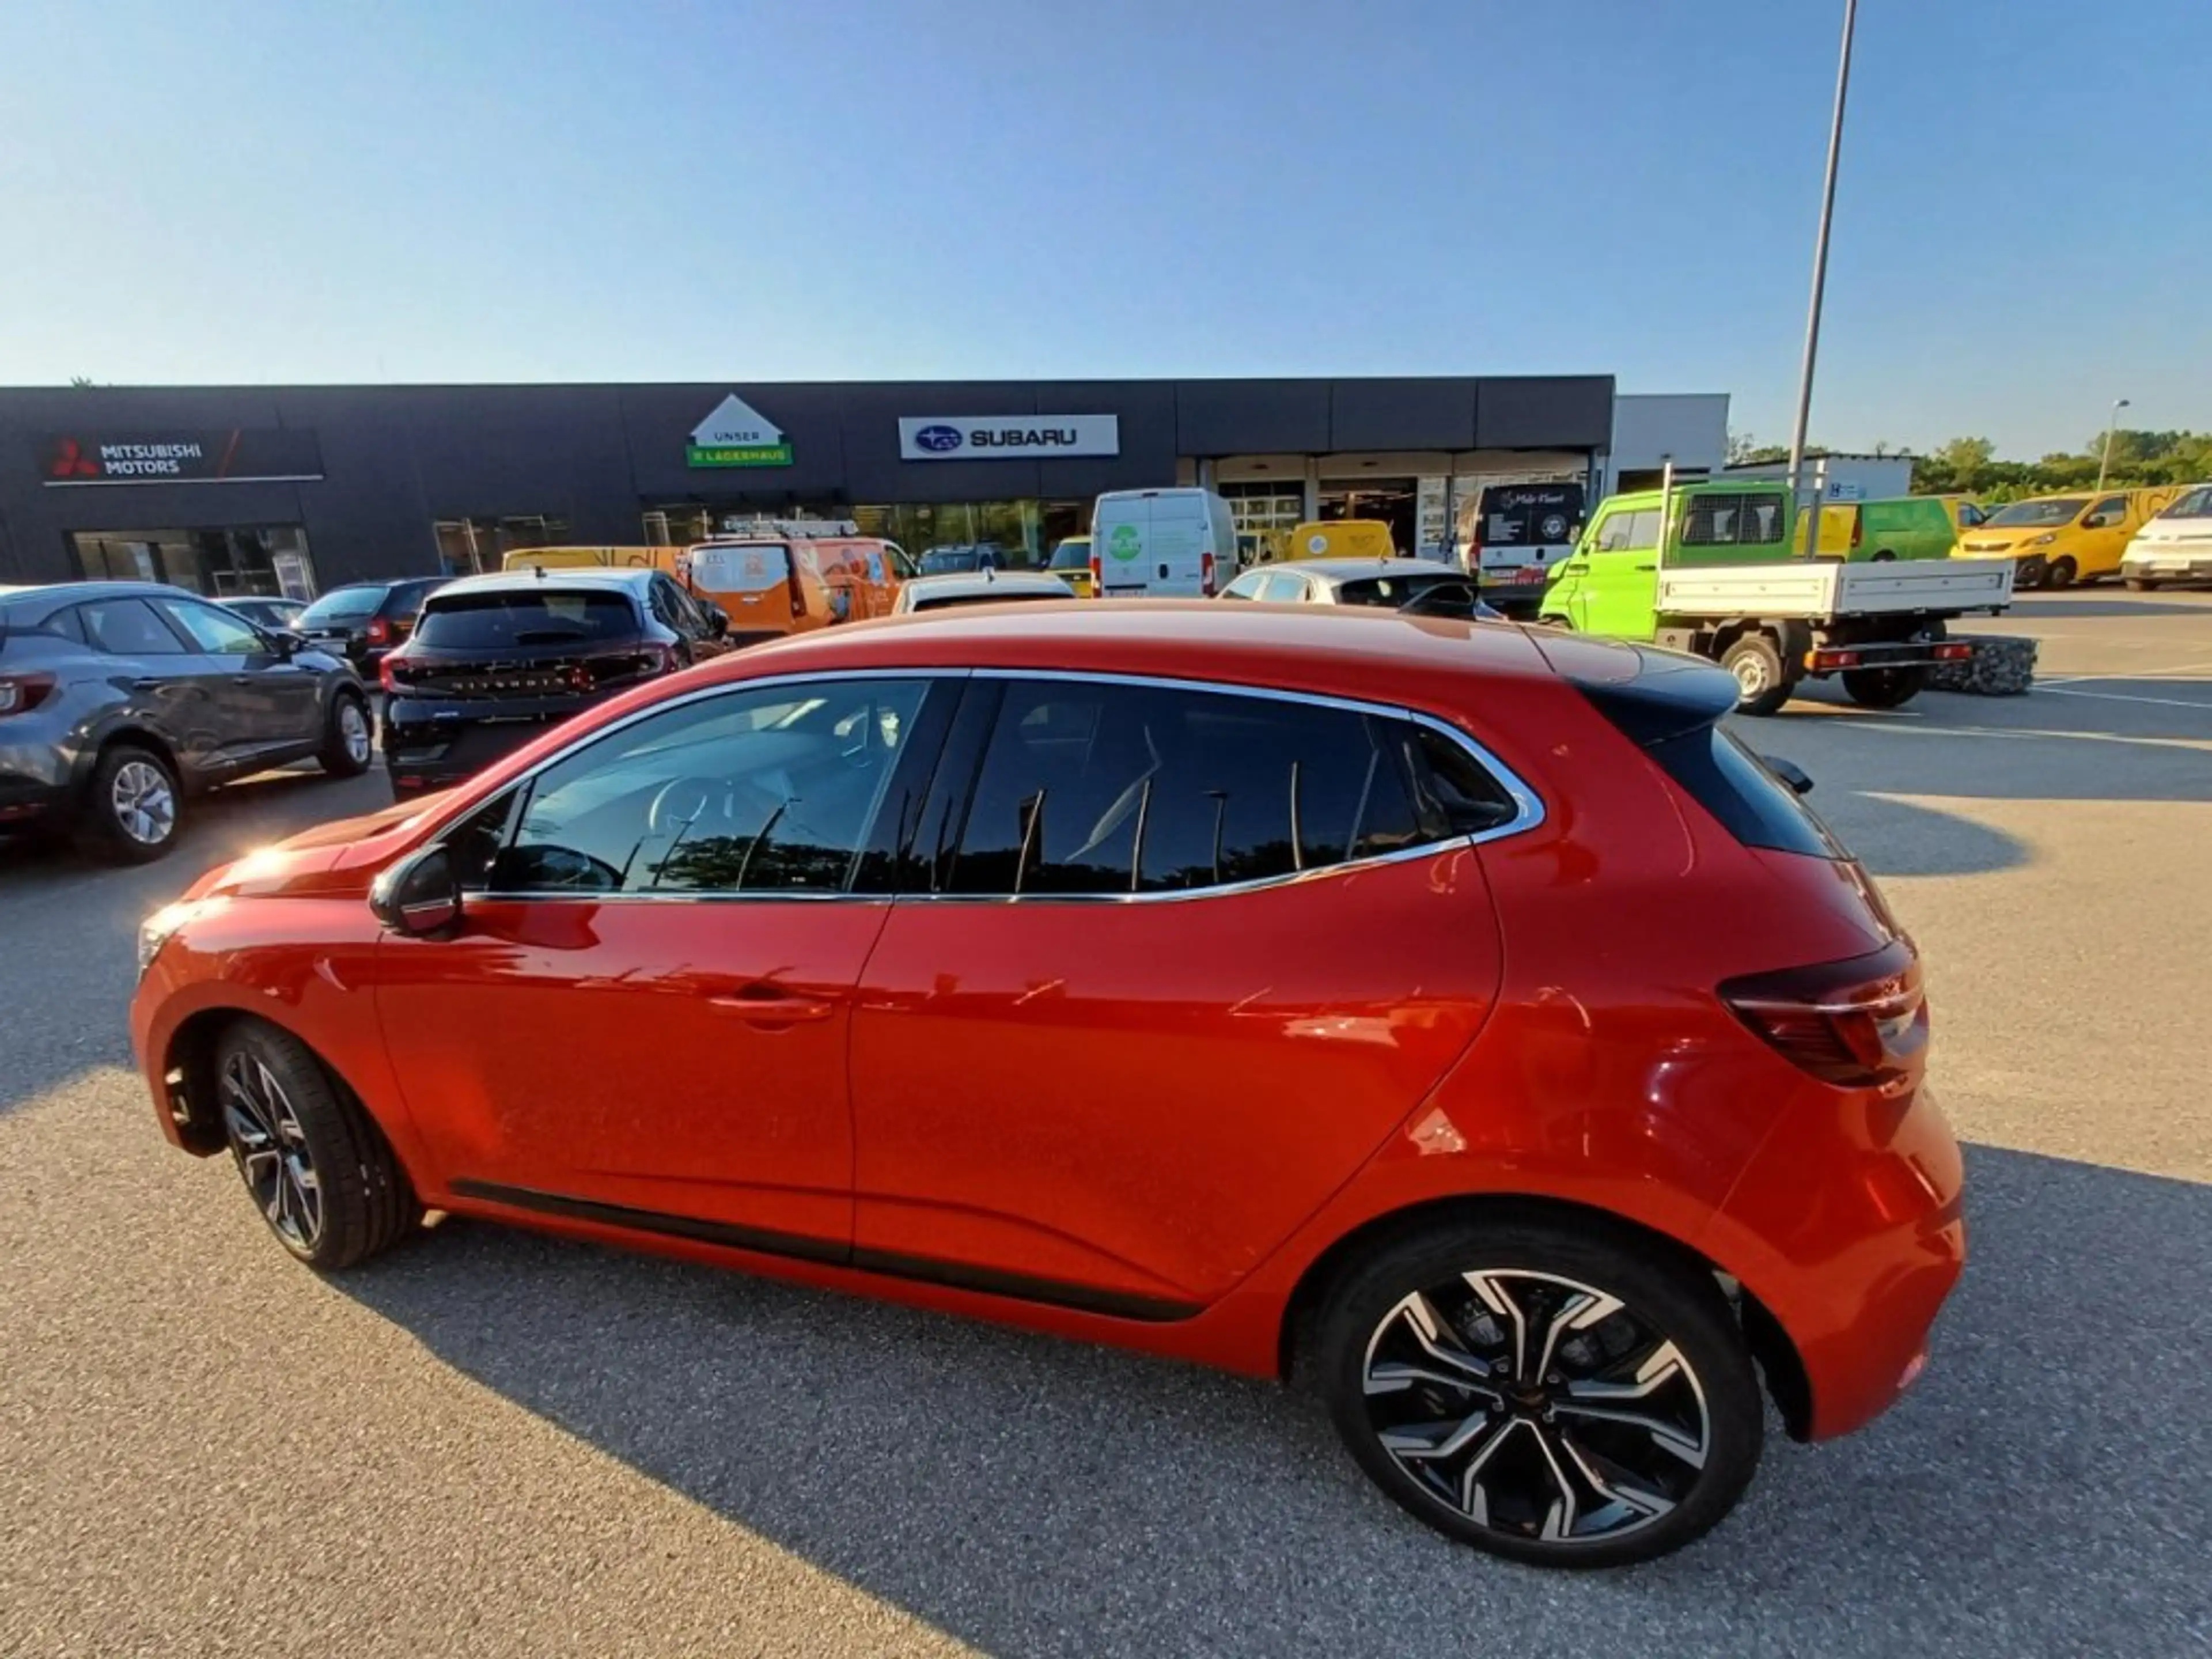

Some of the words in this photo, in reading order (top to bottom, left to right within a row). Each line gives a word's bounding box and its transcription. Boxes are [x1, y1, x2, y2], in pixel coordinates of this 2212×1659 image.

[714, 432, 759, 441] UNSER
[970, 429, 1077, 447] SUBARU
[100, 442, 202, 459] MITSUBISHI
[104, 460, 180, 474] MOTORS
